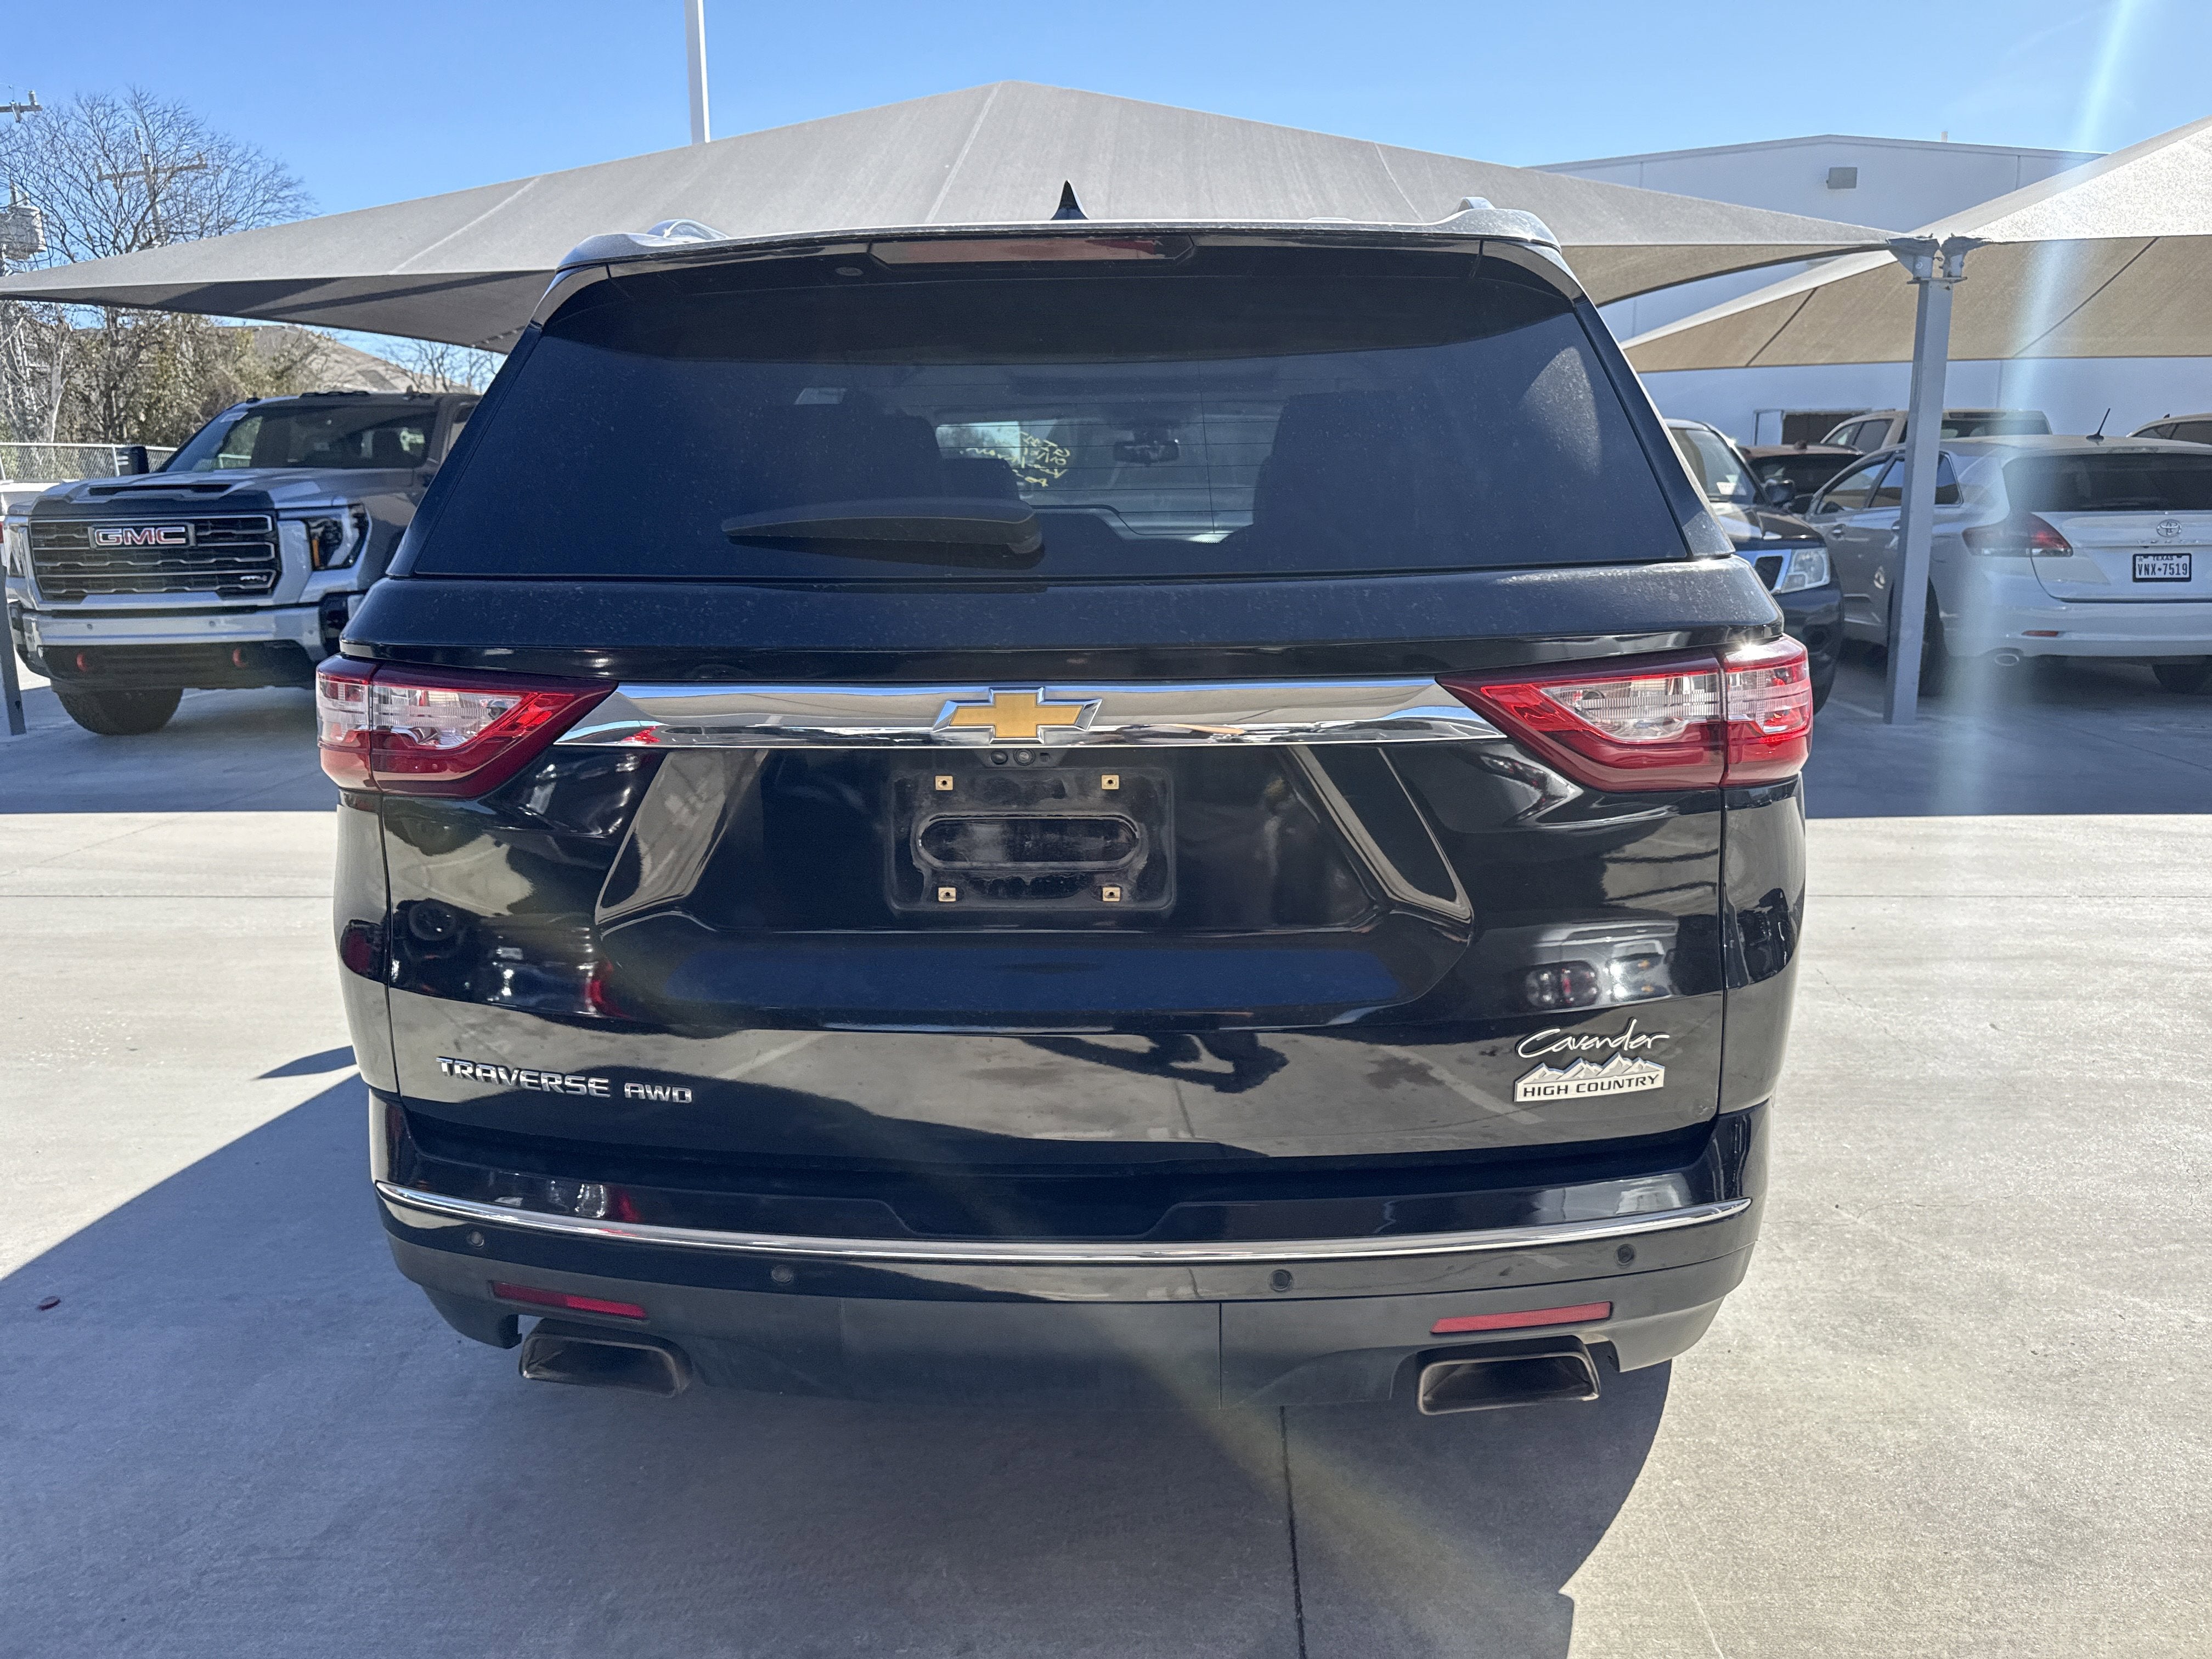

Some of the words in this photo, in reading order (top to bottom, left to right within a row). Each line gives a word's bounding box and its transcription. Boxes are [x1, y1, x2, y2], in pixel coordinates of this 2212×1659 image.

[95, 527, 186, 545] GMC
[1517, 1018, 1671, 1058] Cavender
[436, 1056, 611, 1097] TRAVERSE
[624, 1082, 693, 1104] AWD
[1523, 1085, 1568, 1097] HIGH
[1576, 1074, 1660, 1093] COUNTRY
